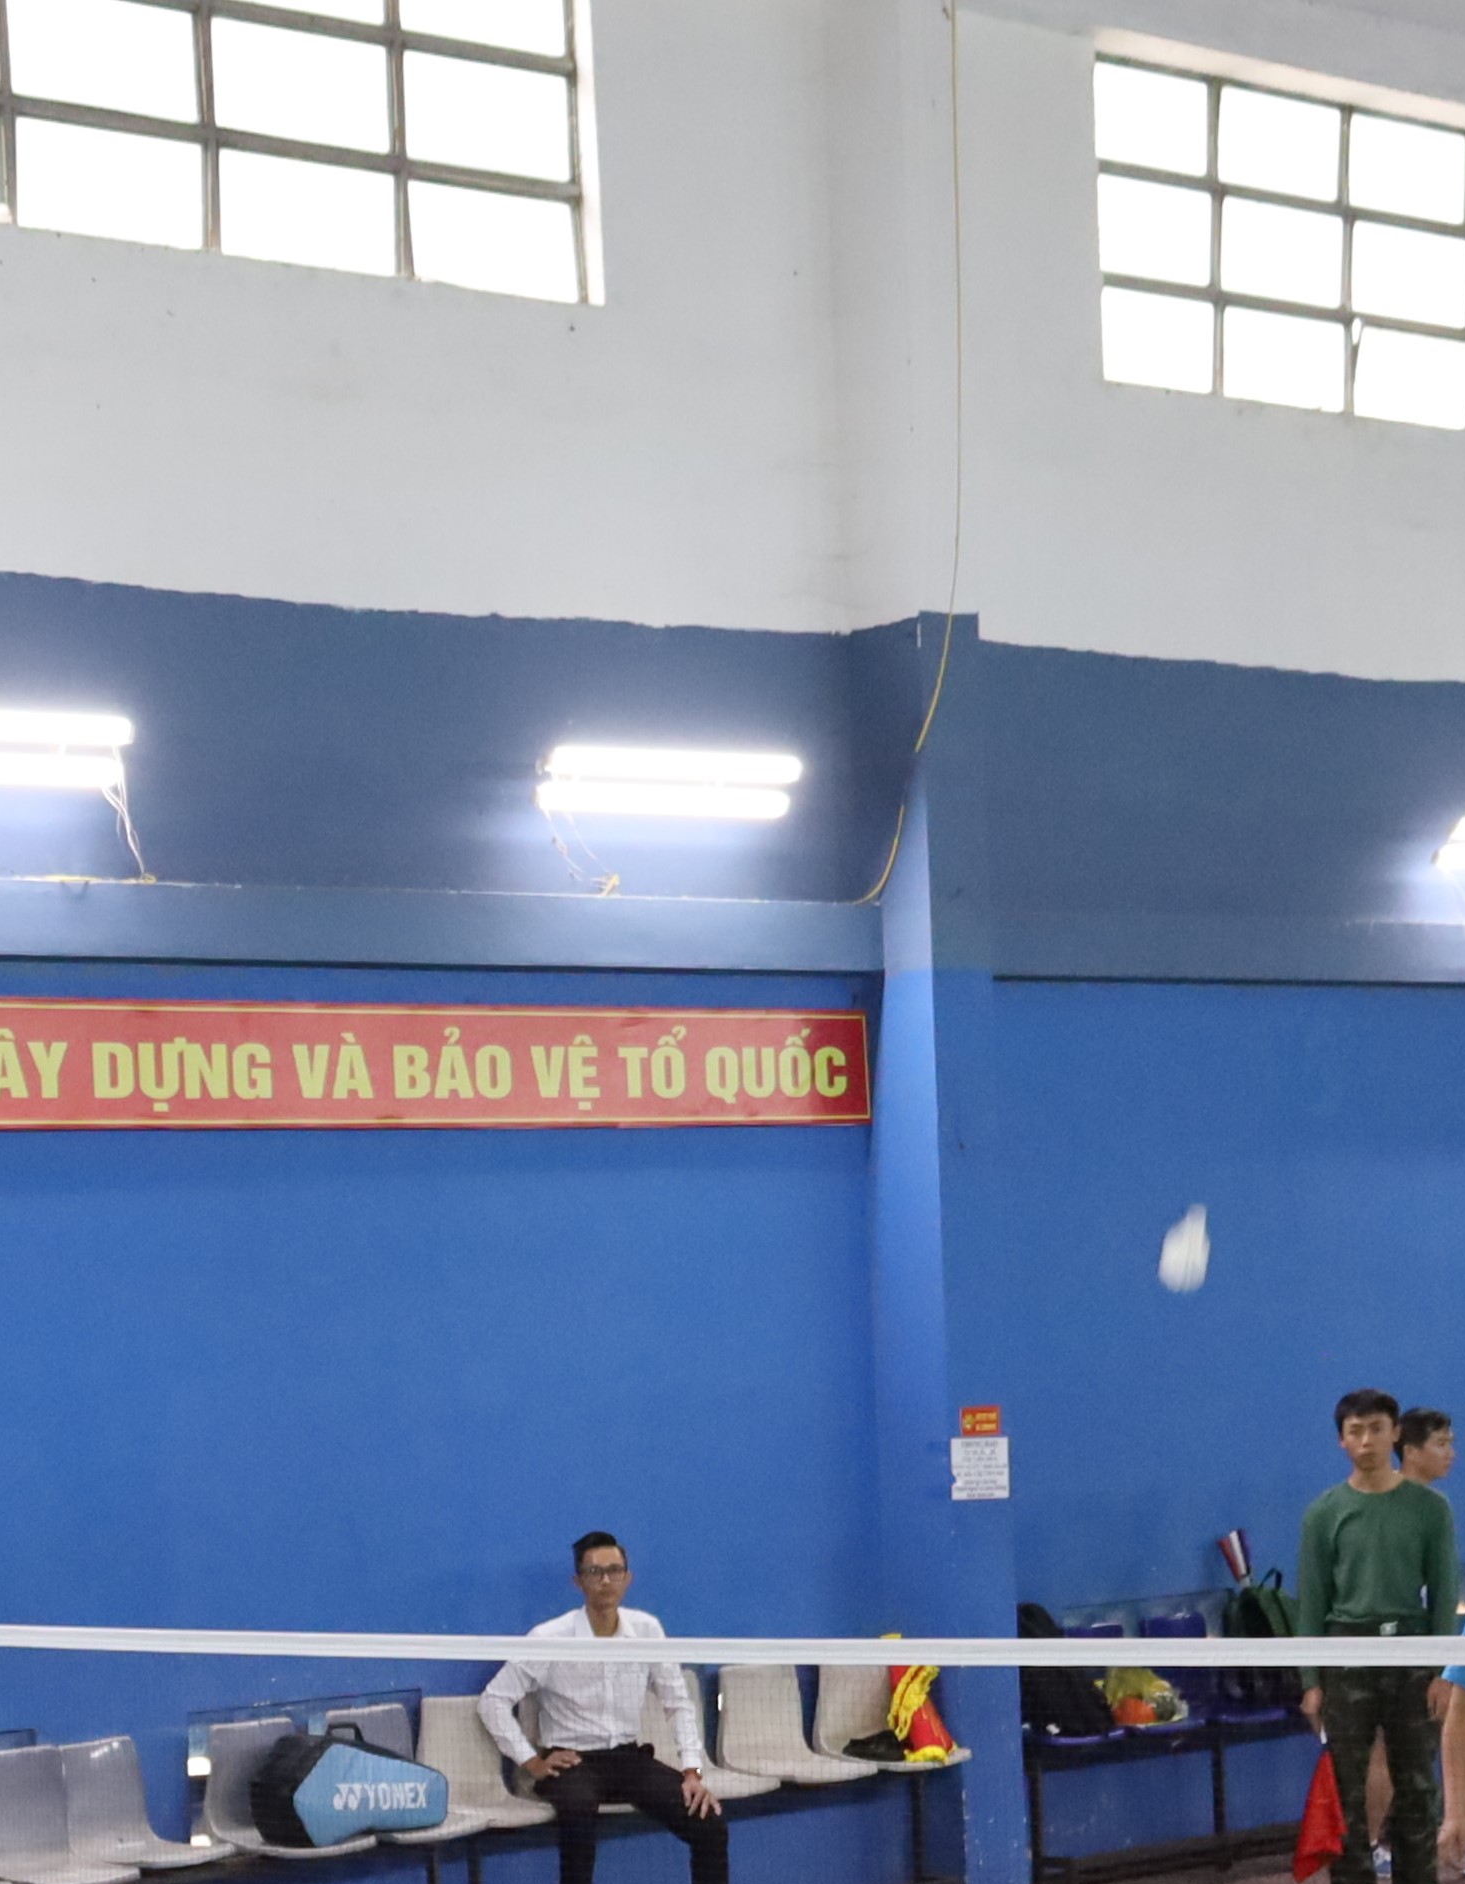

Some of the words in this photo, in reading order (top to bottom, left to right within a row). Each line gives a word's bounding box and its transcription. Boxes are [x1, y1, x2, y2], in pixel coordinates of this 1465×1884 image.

[93, 1037, 272, 1112] DỰNG
[293, 1033, 373, 1098] VÀ
[393, 1026, 512, 1099] BẢO
[531, 1036, 600, 1108] VỆ
[619, 1027, 685, 1097] TỔ
[706, 1029, 846, 1103] QUỐC
[363, 1782, 427, 1811] YONEX
